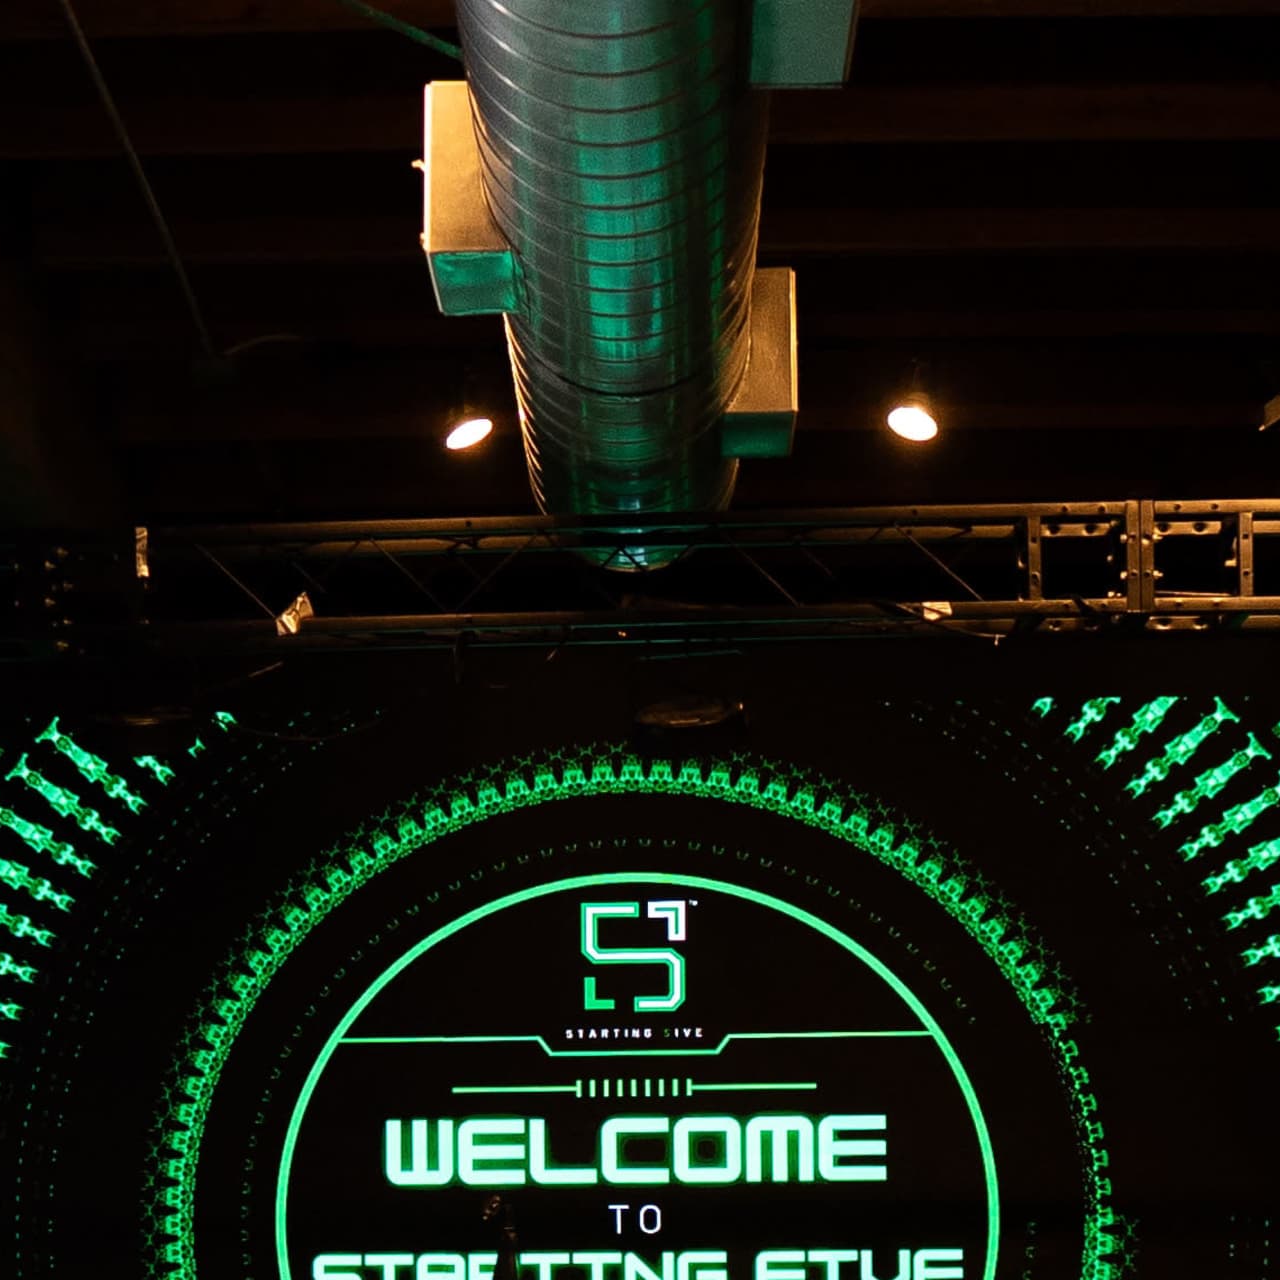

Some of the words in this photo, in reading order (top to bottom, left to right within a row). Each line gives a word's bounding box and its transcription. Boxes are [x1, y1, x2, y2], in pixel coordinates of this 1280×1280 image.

[564, 1027, 653, 1040] STARTING
[385, 1114, 888, 1185] WELCOME
[608, 1204, 662, 1234] TO
